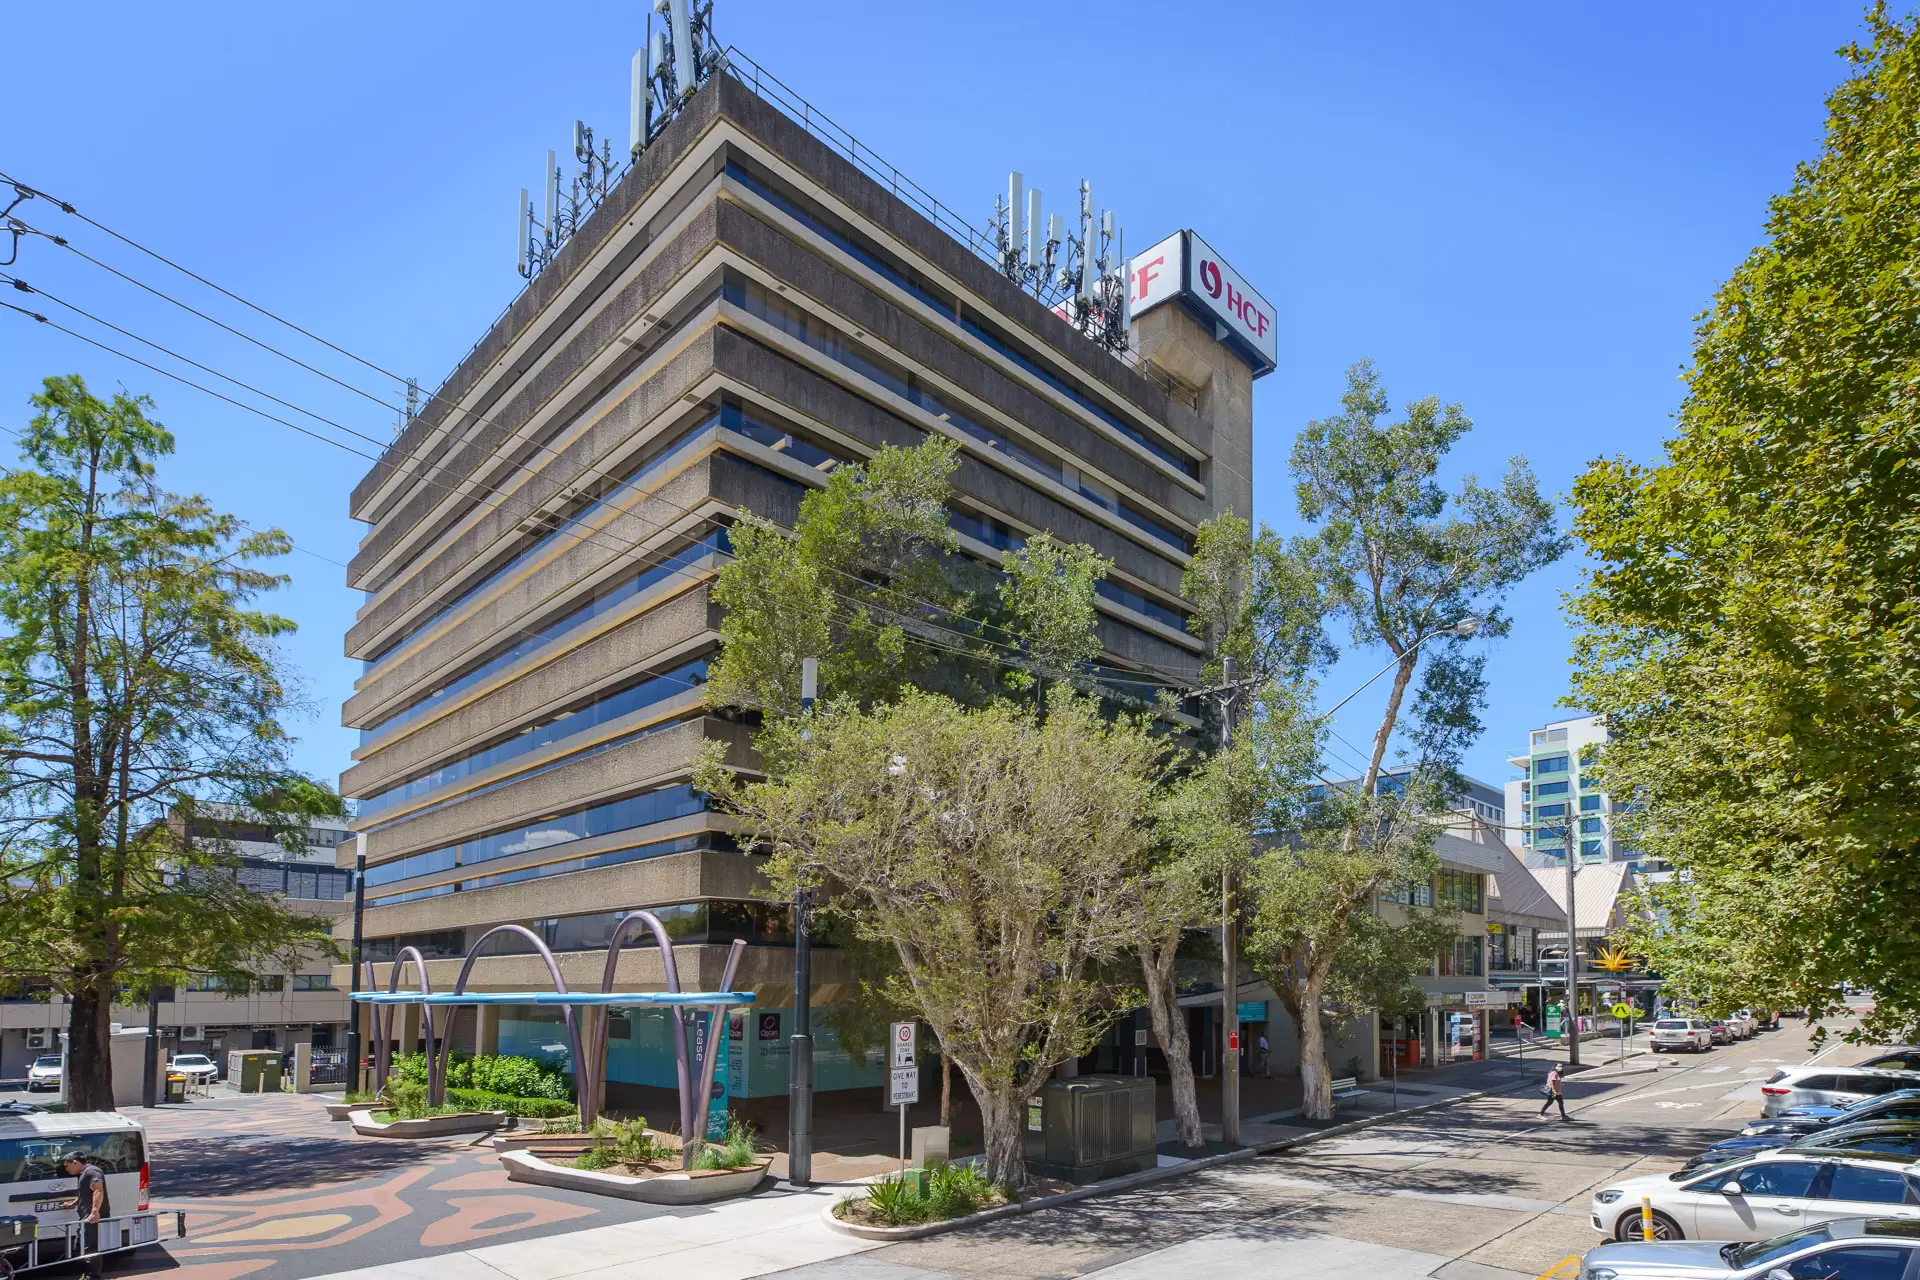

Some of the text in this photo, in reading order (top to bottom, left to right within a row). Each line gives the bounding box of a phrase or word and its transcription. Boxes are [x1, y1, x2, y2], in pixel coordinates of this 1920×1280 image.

[1226, 281, 1270, 338] HCF
[696, 1020, 706, 1062] Lease
[905, 1071, 916, 1079] WAY
[893, 1091, 916, 1100] PEDESTRIANS
